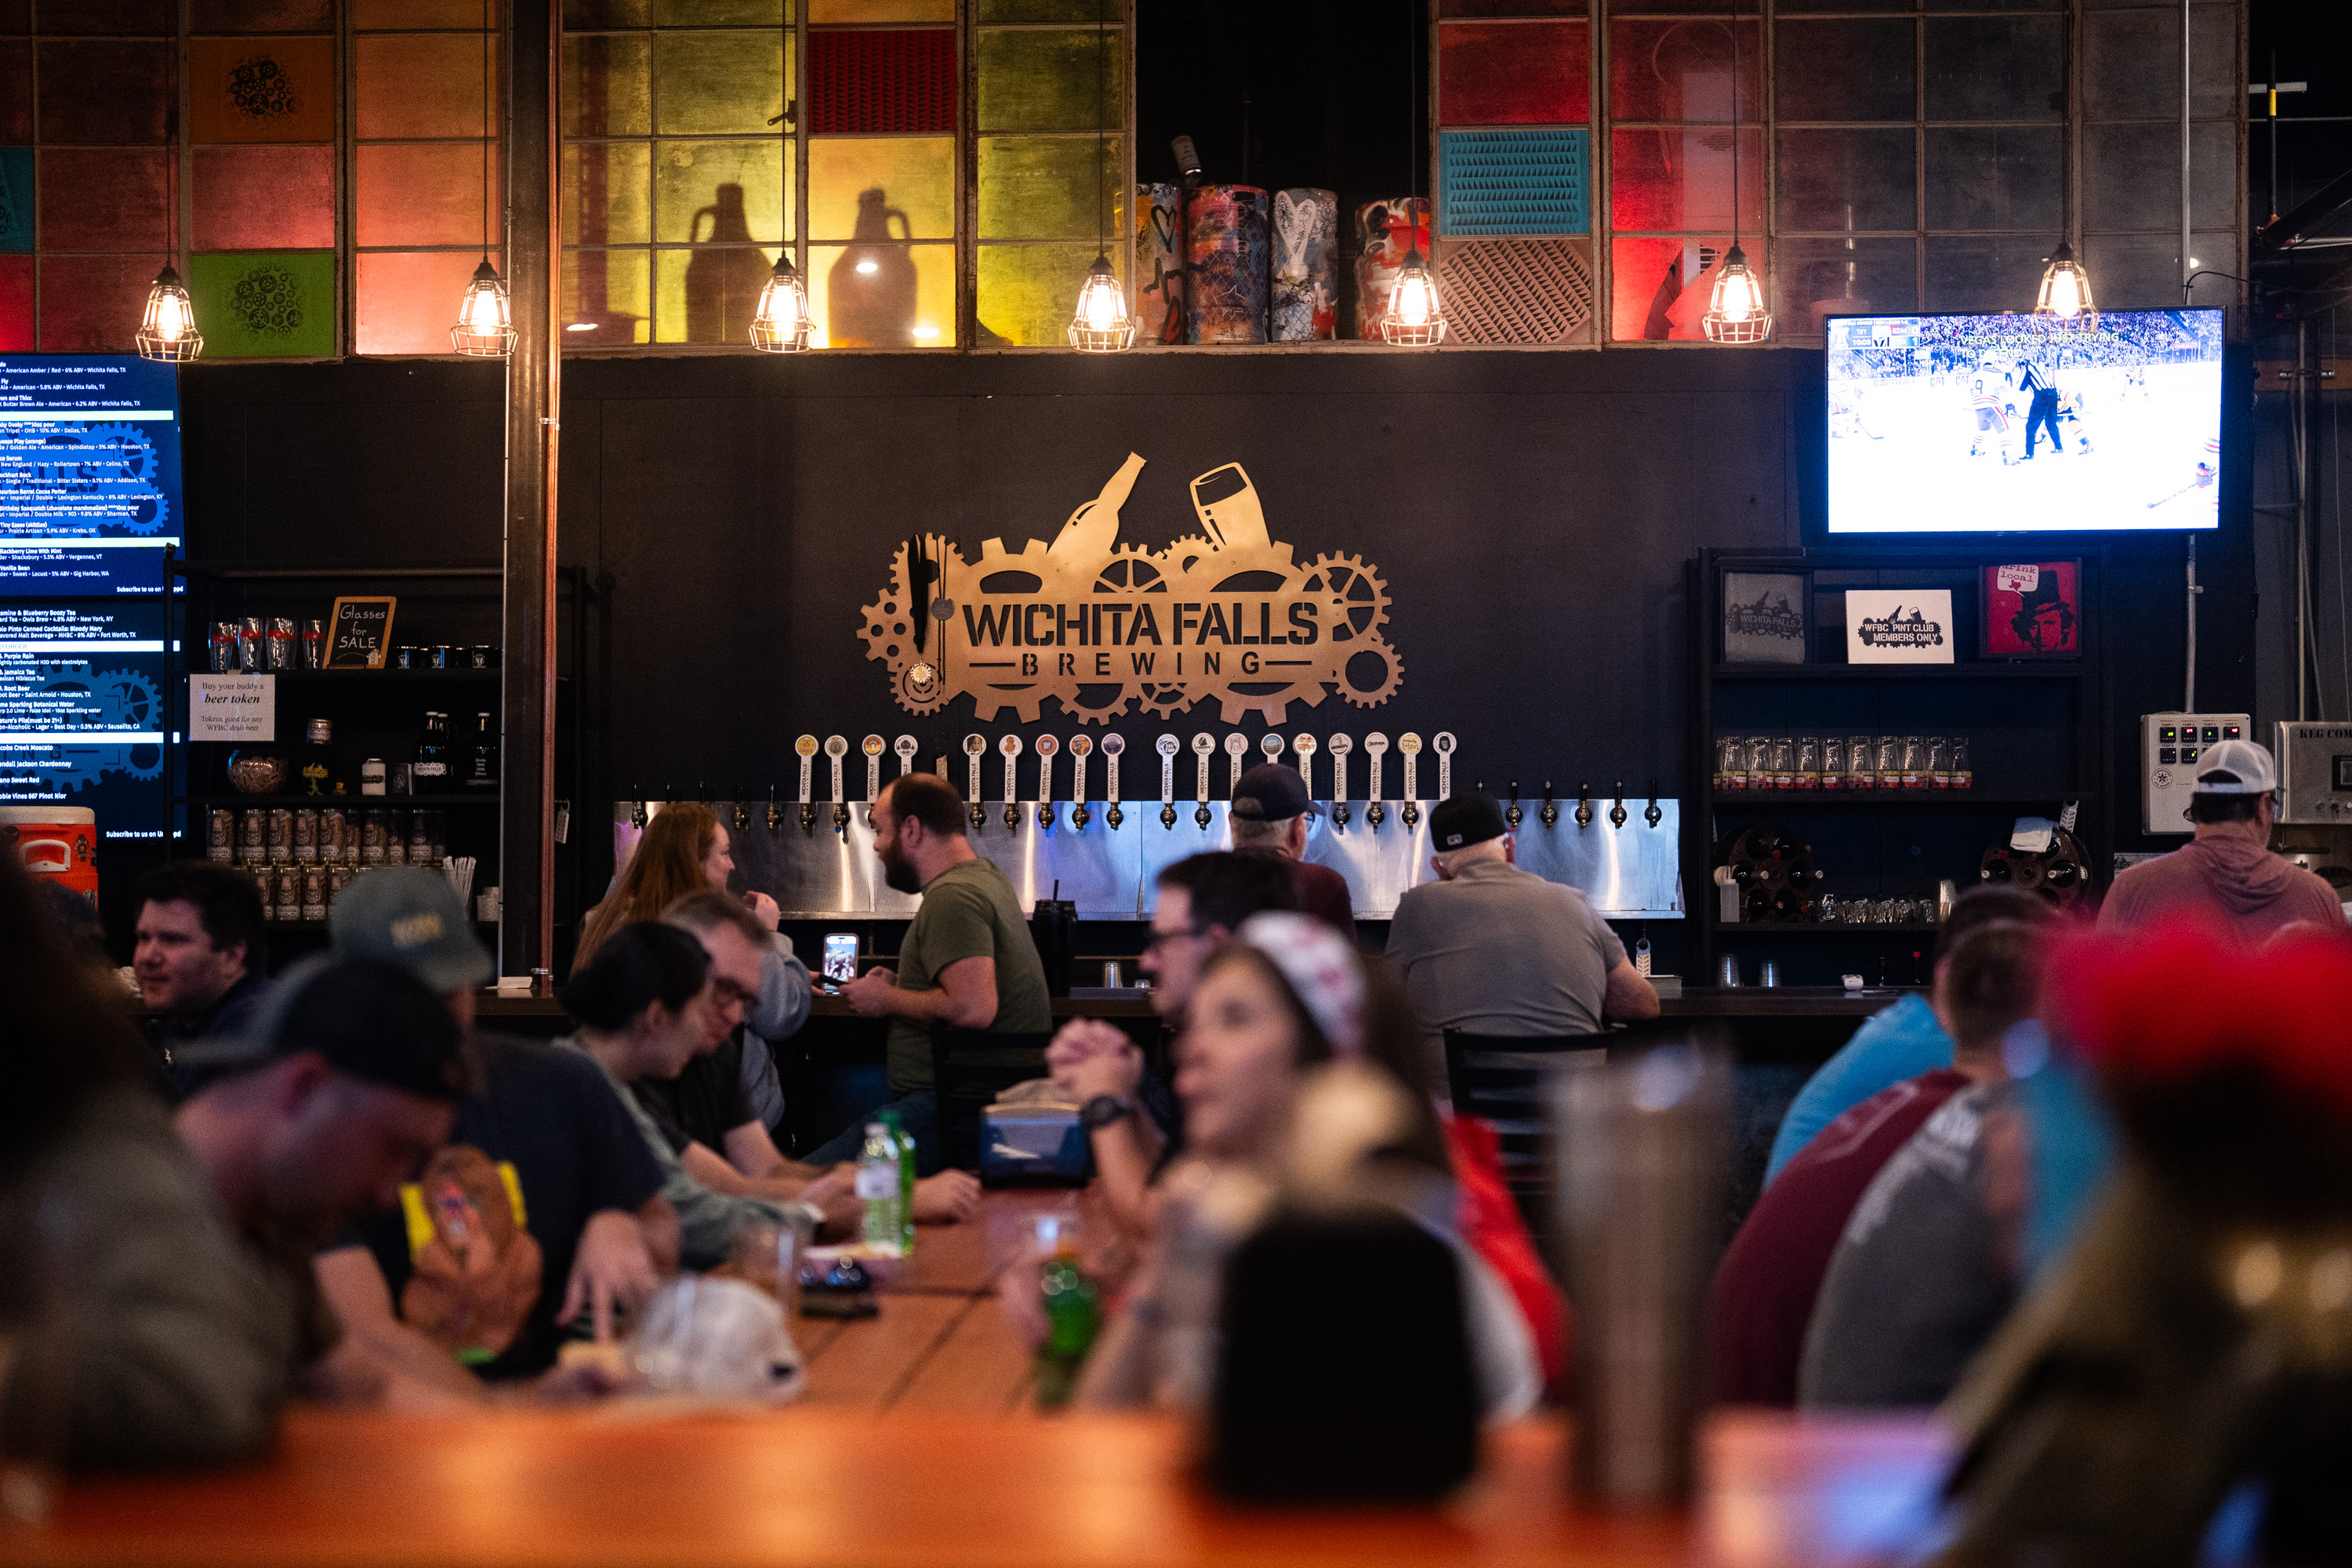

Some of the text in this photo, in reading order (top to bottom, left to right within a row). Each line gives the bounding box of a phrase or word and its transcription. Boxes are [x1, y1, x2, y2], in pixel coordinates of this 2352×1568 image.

[1960, 332, 2120, 345] VEGAS LOOKED JUST TRYING
[2001, 571, 2034, 582] local
[340, 604, 386, 619] Glasses
[962, 602, 1319, 646] WICHITA FALLS
[1740, 615, 1796, 628] WICHITA FALLS
[1864, 623, 1889, 632] WFBC
[351, 621, 367, 636] for
[339, 636, 376, 648] SALE
[1022, 652, 1260, 676] BREWING
[202, 682, 216, 691] Buy
[237, 682, 258, 691] buddy
[205, 693, 260, 704] beer token
[2299, 729, 2324, 739] KEG
